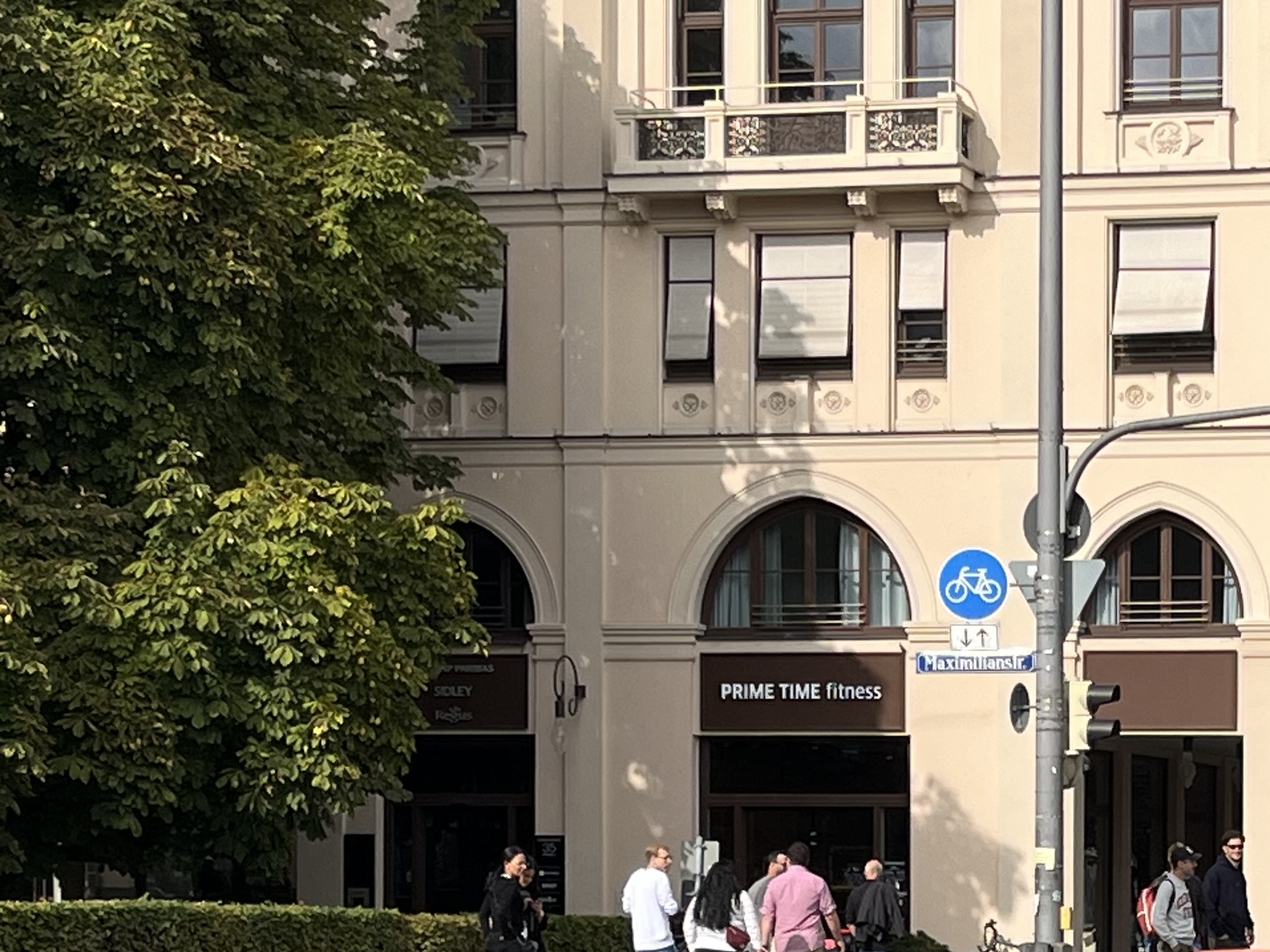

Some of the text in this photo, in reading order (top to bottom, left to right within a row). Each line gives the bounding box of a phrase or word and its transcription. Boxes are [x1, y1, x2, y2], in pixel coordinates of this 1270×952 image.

[924, 655, 1027, 671] Maximilianstr.
[433, 685, 473, 697] SIDLEY
[721, 682, 882, 700] PRIME TIME fitness
